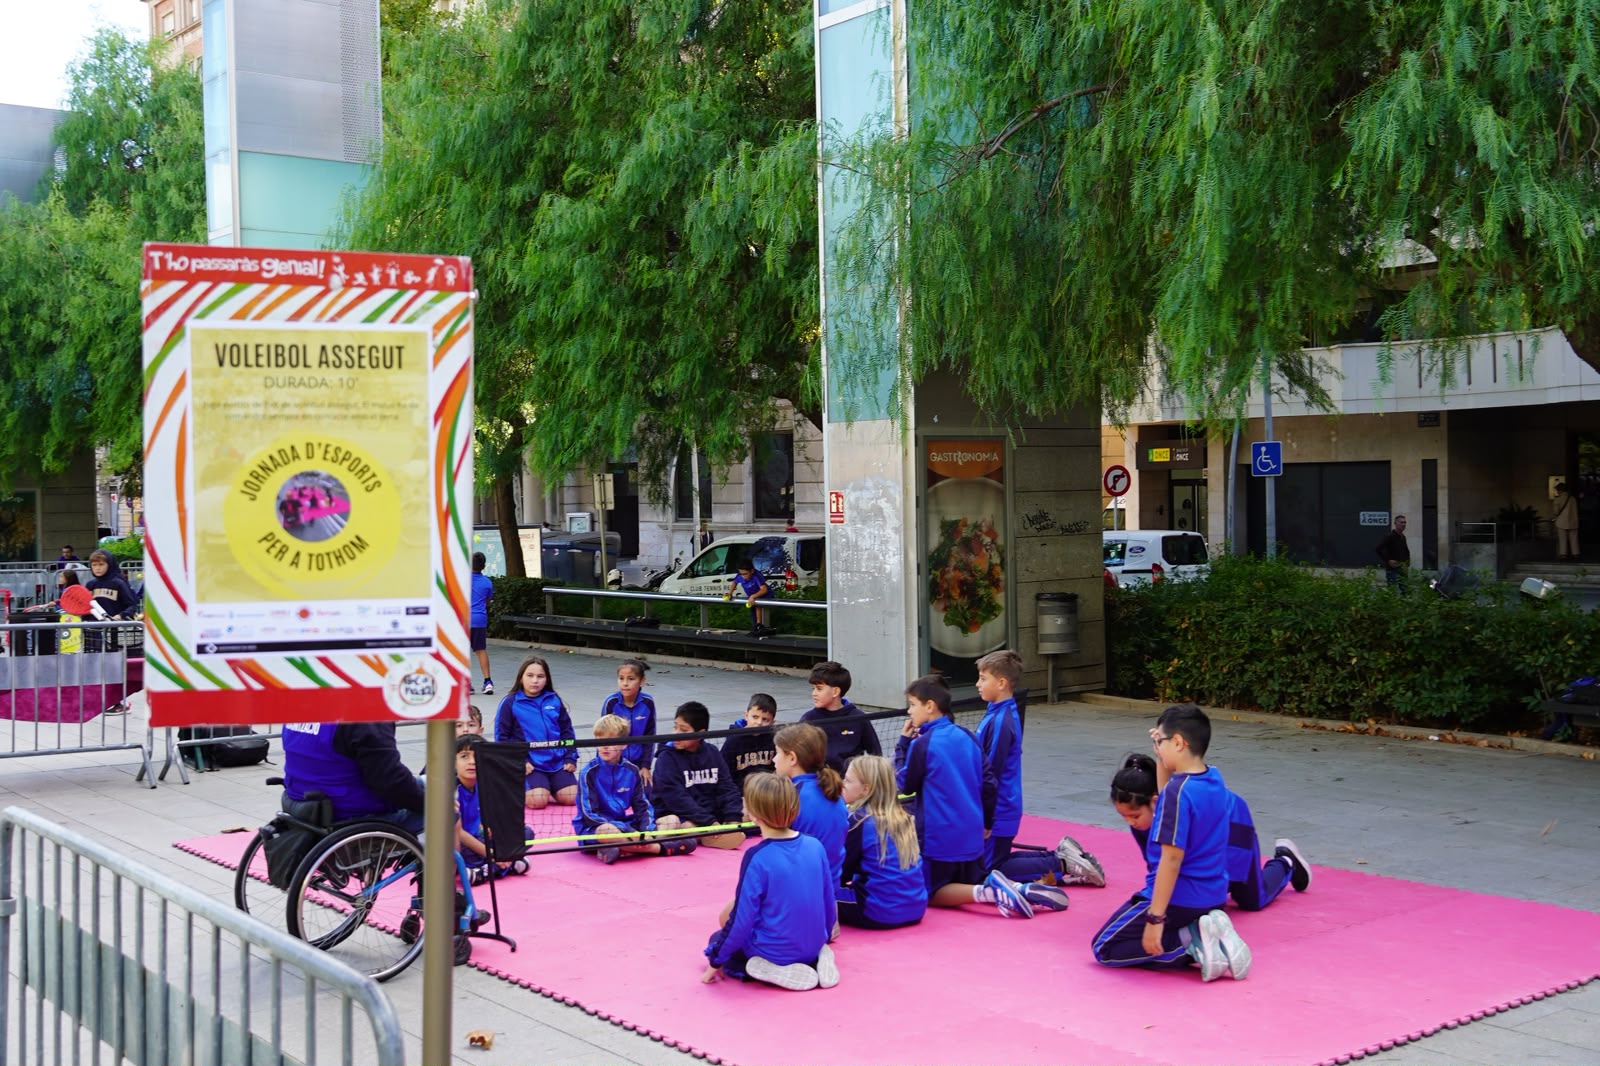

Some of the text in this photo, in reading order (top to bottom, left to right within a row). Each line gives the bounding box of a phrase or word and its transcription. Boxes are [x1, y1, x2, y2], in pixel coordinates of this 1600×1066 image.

[149, 250, 326, 280] T'ho passaràs genial!
[215, 343, 405, 370] VOLEIBOL ASSEGUT
[263, 376, 359, 391] DURADA: 10'
[929, 450, 999, 466] GASTRONOMIA
[1176, 453, 1189, 461] ONCE
[240, 441, 382, 501] JORNADA D'ESPORTS
[257, 532, 370, 571] PER A TOTHOM
